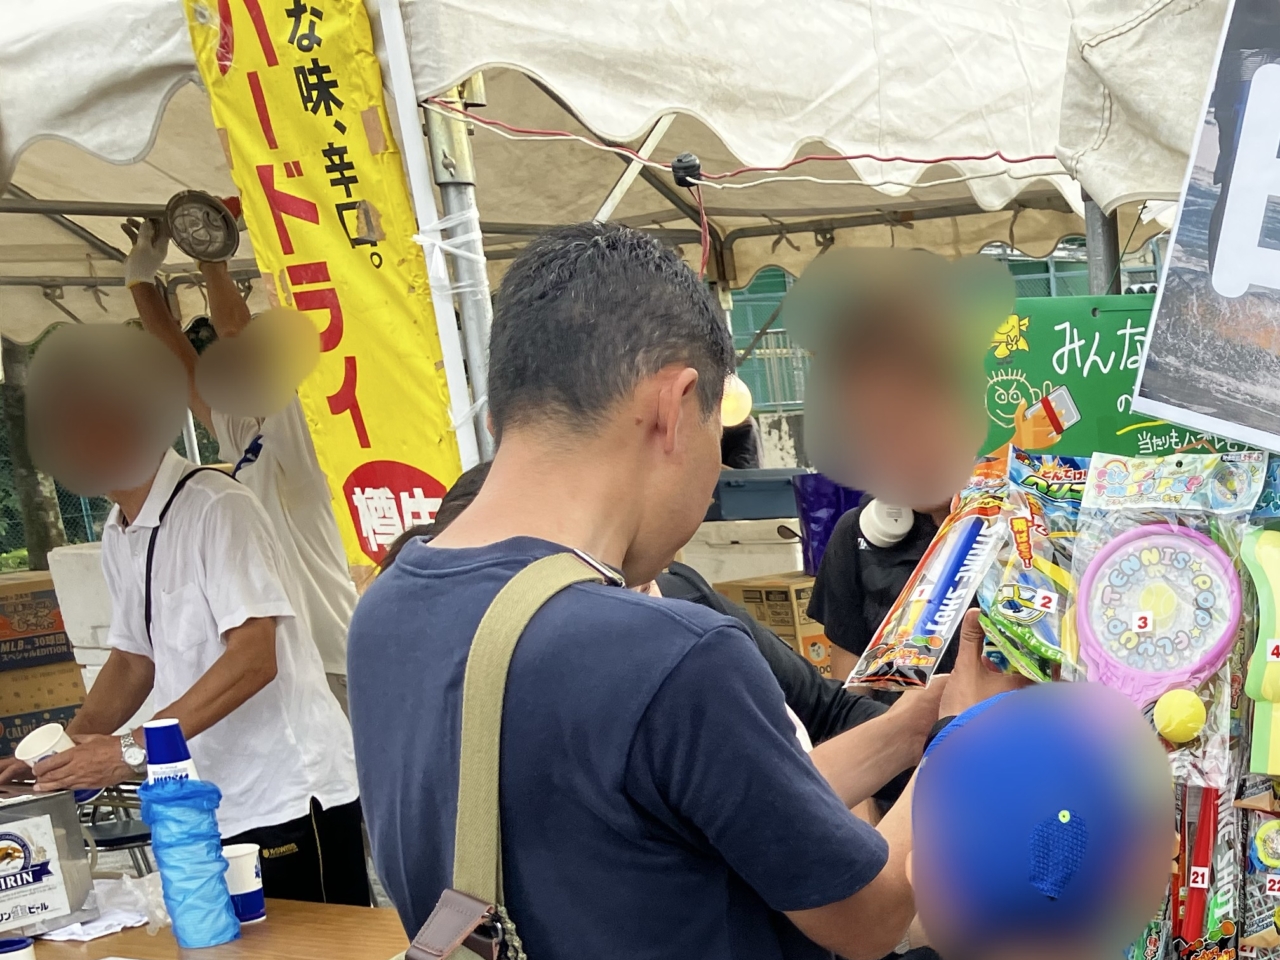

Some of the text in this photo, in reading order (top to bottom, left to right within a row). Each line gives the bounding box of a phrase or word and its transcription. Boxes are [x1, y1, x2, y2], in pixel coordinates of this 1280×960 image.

[918, 587, 925, 598] 1
[1101, 546, 1192, 606] TENNIS
[1191, 573, 1217, 628] POP
[926, 586, 969, 635] SHOT
[1040, 595, 1053, 610] 2
[1137, 616, 1149, 630] 3
[0, 870, 34, 890] IRIN
[1191, 871, 1206, 885] 21
[1213, 848, 1235, 919] SHOT
